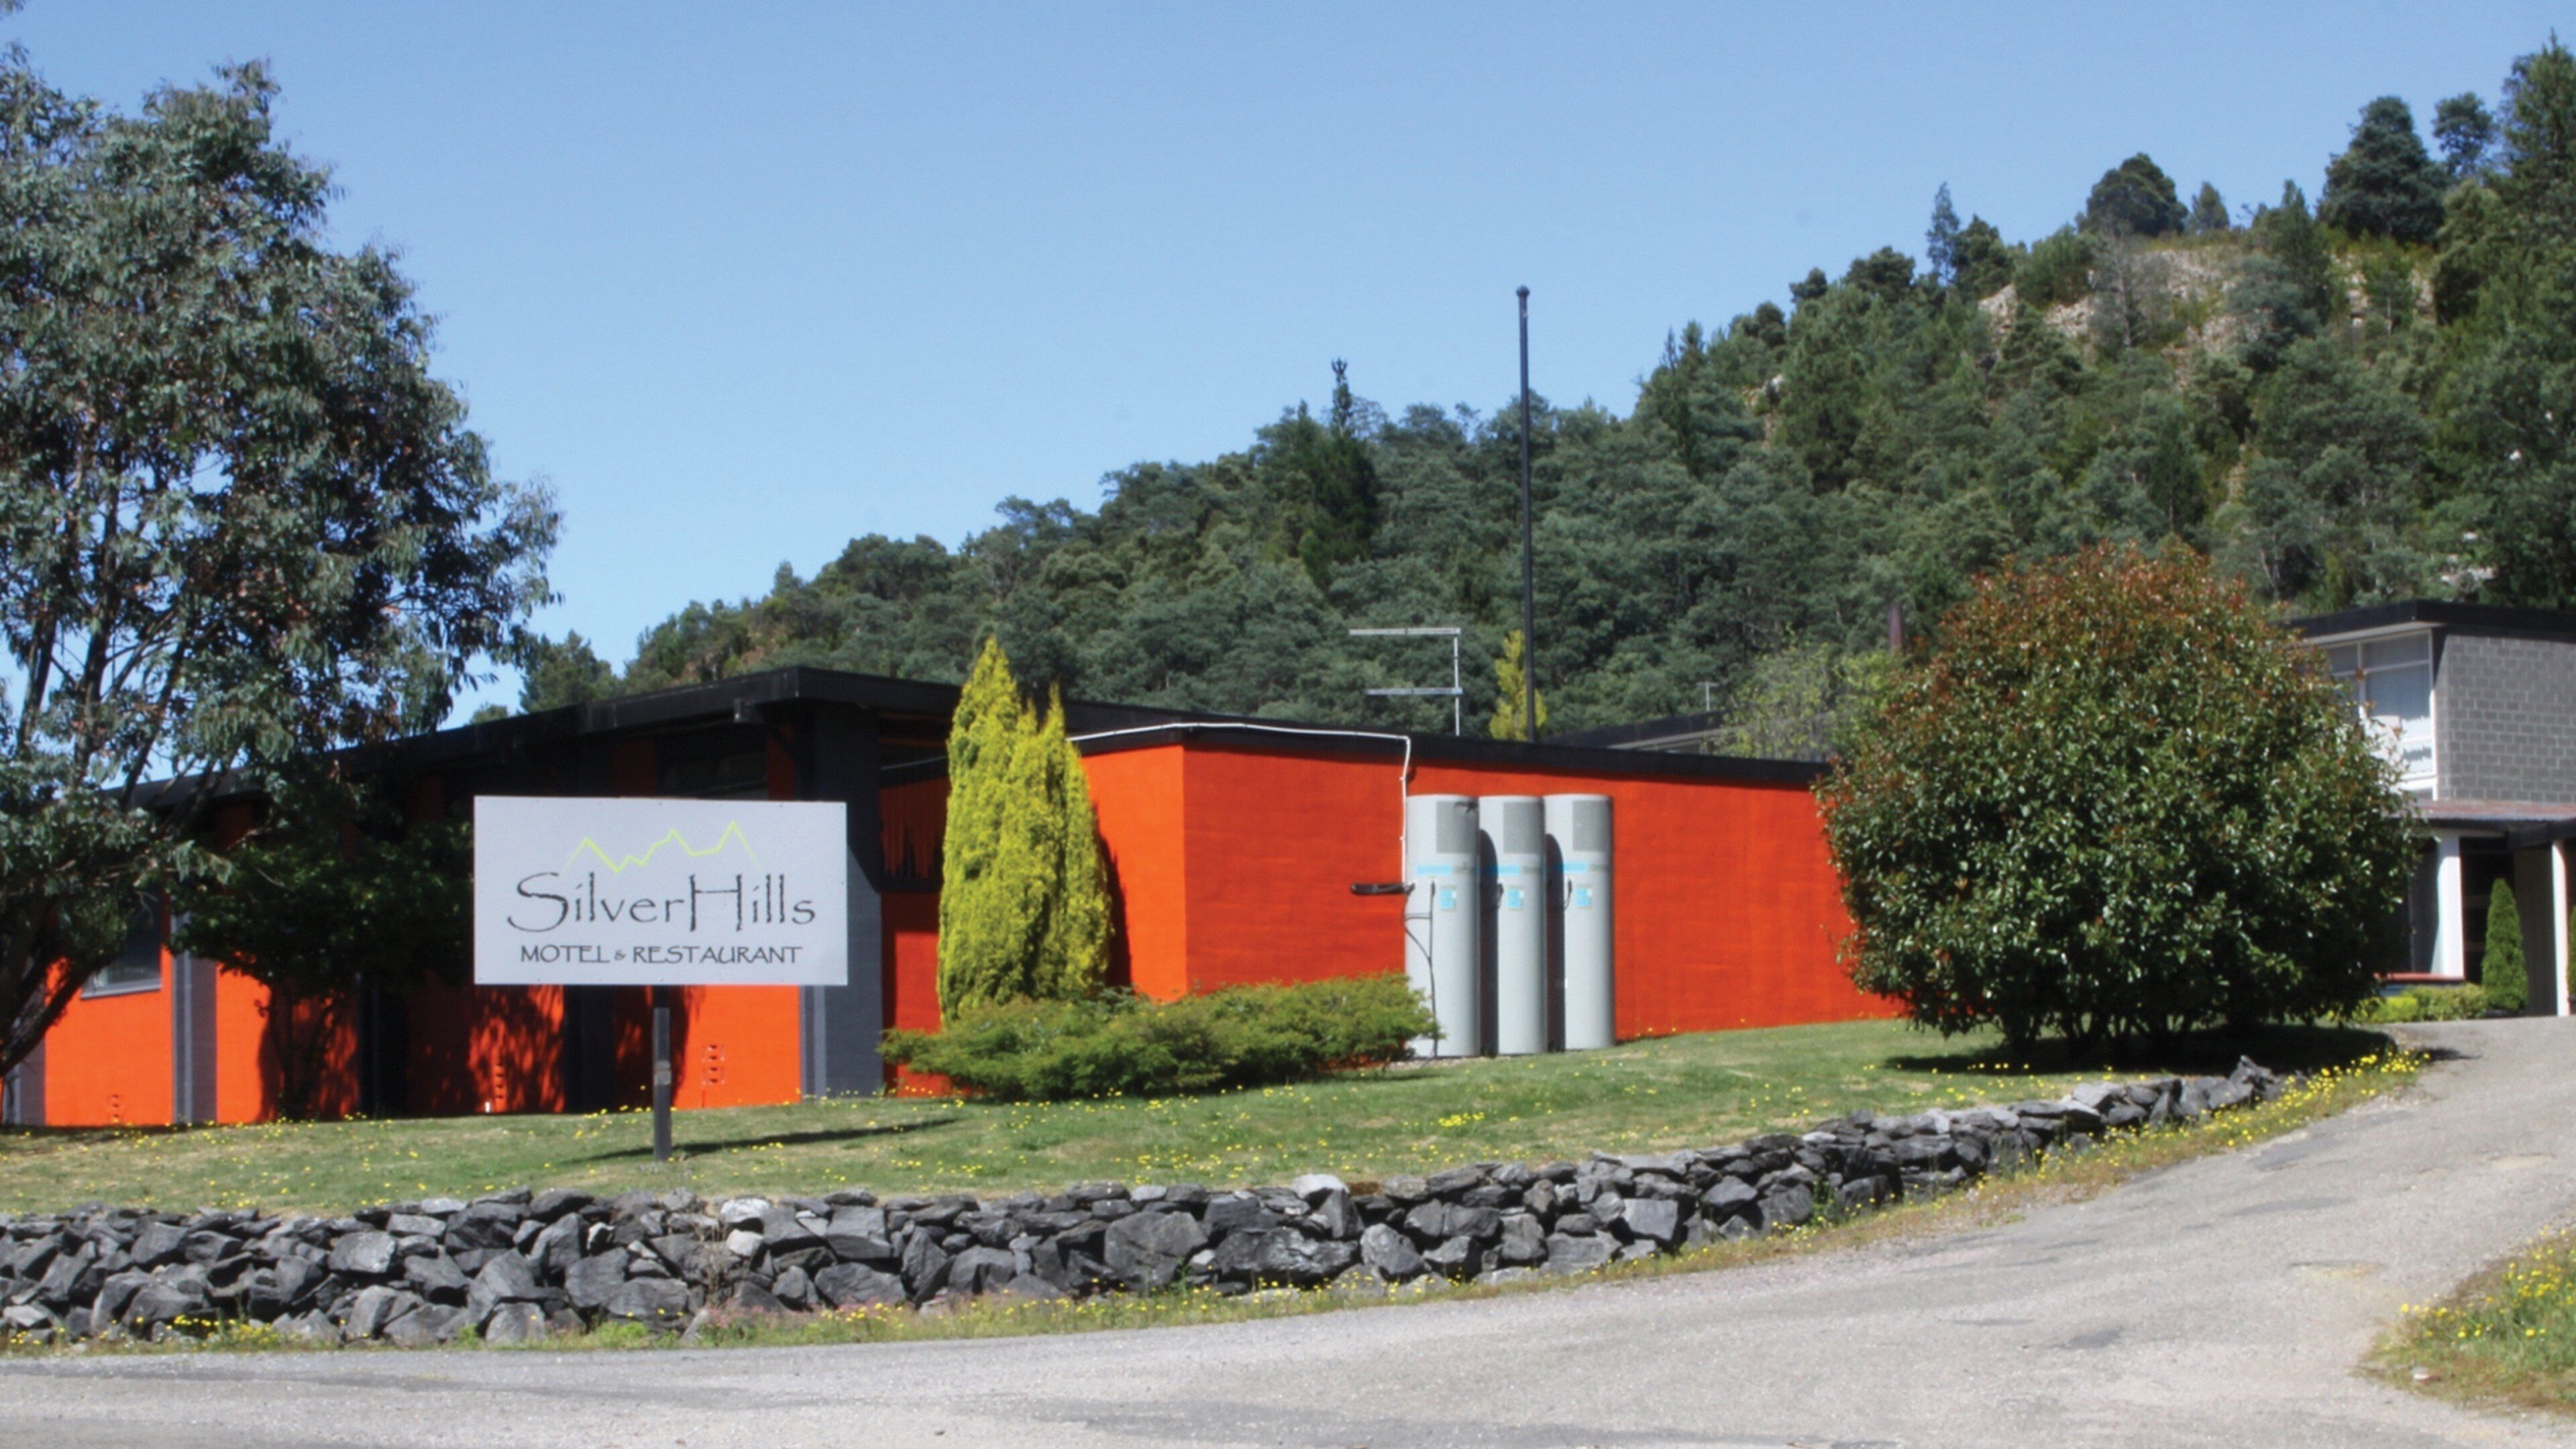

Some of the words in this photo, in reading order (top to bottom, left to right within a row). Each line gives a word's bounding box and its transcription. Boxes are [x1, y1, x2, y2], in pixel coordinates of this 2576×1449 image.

[521, 945, 610, 963] MOTEL
[614, 949, 626, 961] &
[633, 946, 804, 964] RESTAURANT
